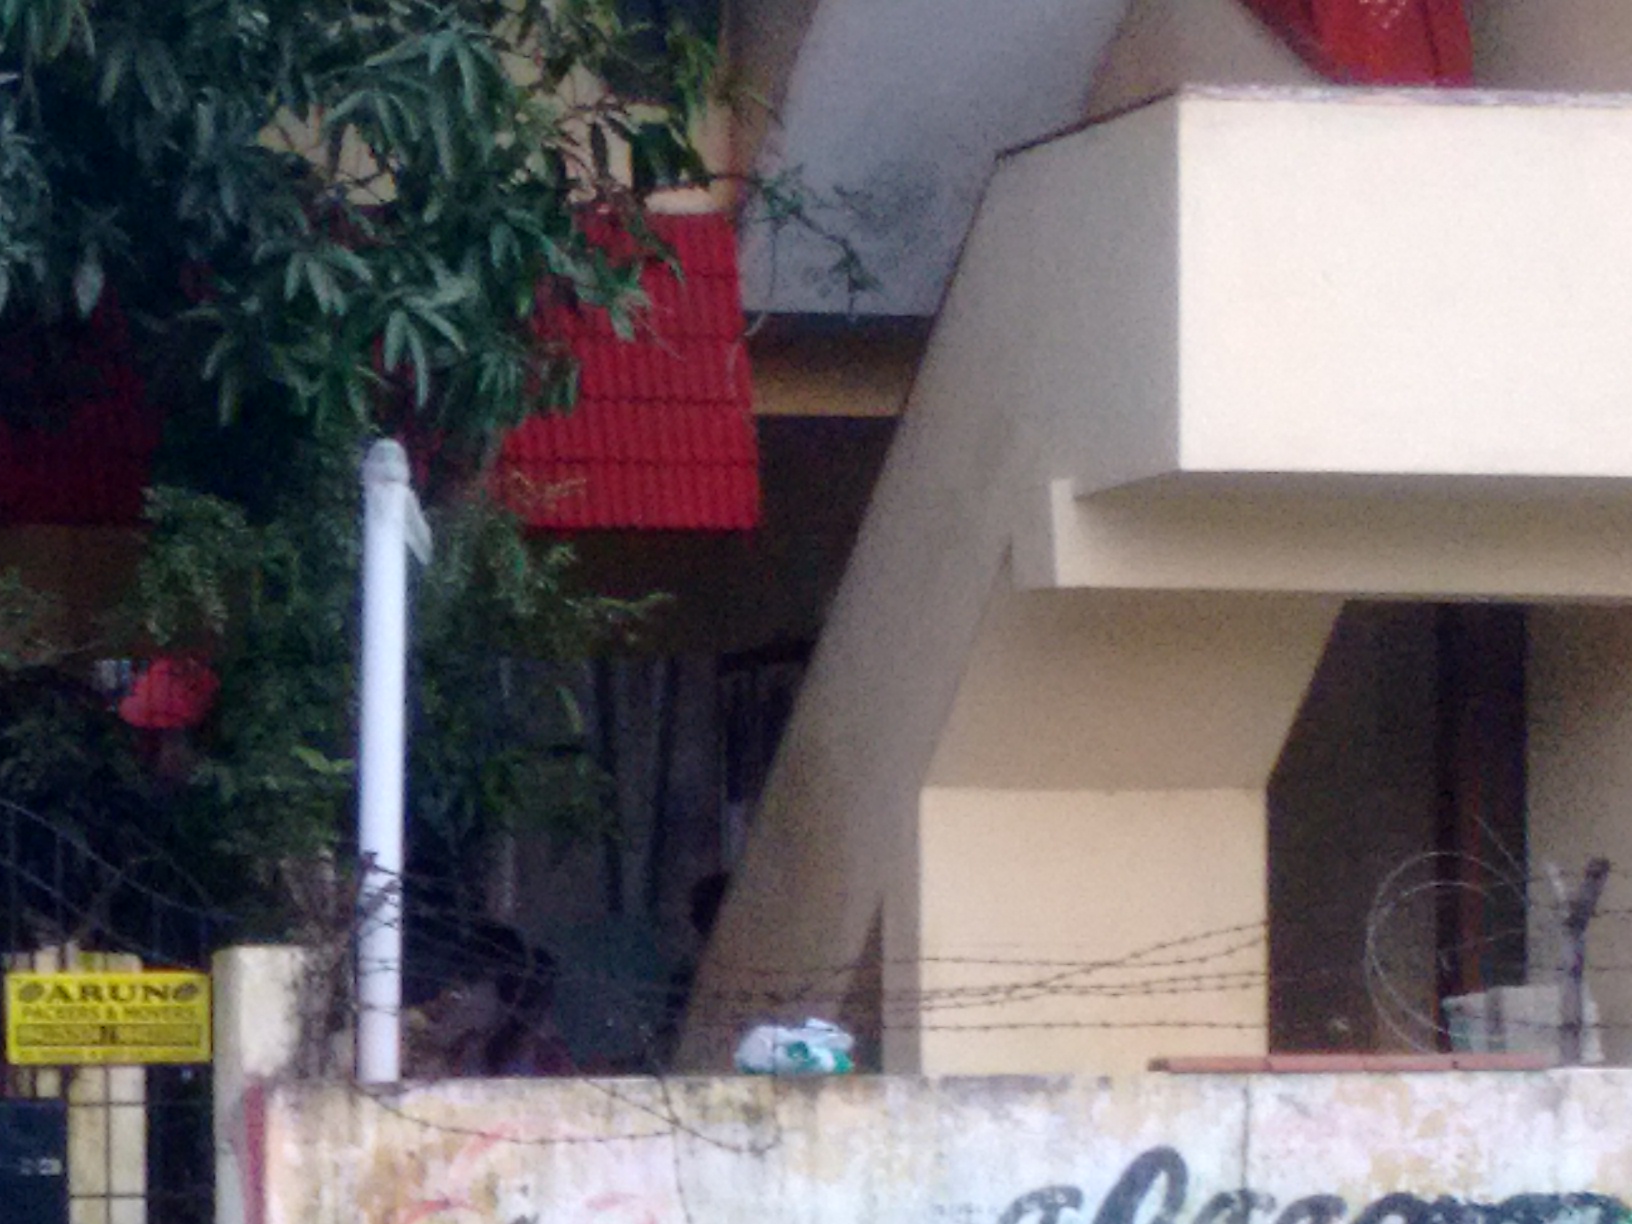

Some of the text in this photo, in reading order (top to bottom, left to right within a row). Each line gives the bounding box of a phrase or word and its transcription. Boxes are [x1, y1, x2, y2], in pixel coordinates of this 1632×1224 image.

[48, 984, 171, 1001] ARUN
[22, 1005, 99, 1020] PACKERS
[124, 1005, 197, 1020] MOVERS
